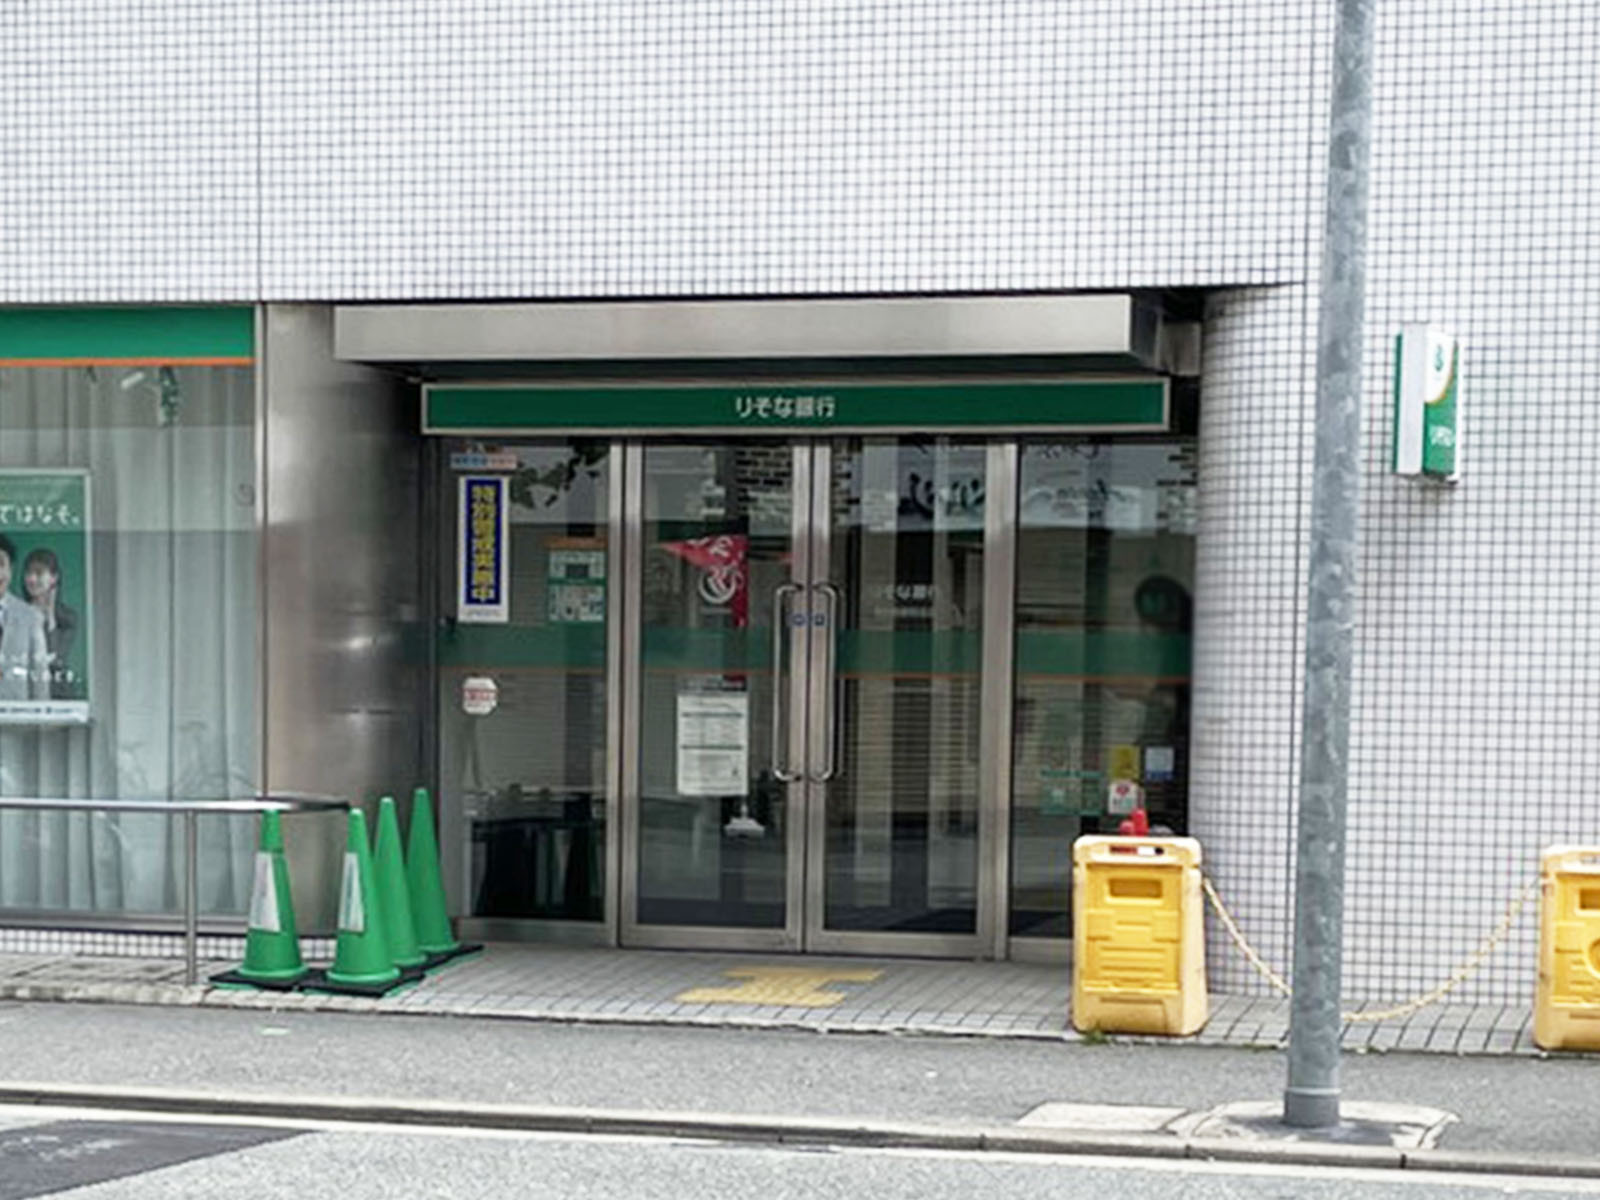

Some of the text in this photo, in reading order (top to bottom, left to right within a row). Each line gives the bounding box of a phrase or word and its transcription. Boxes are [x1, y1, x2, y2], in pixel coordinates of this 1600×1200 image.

[735, 396, 835, 418] りそな銀行
